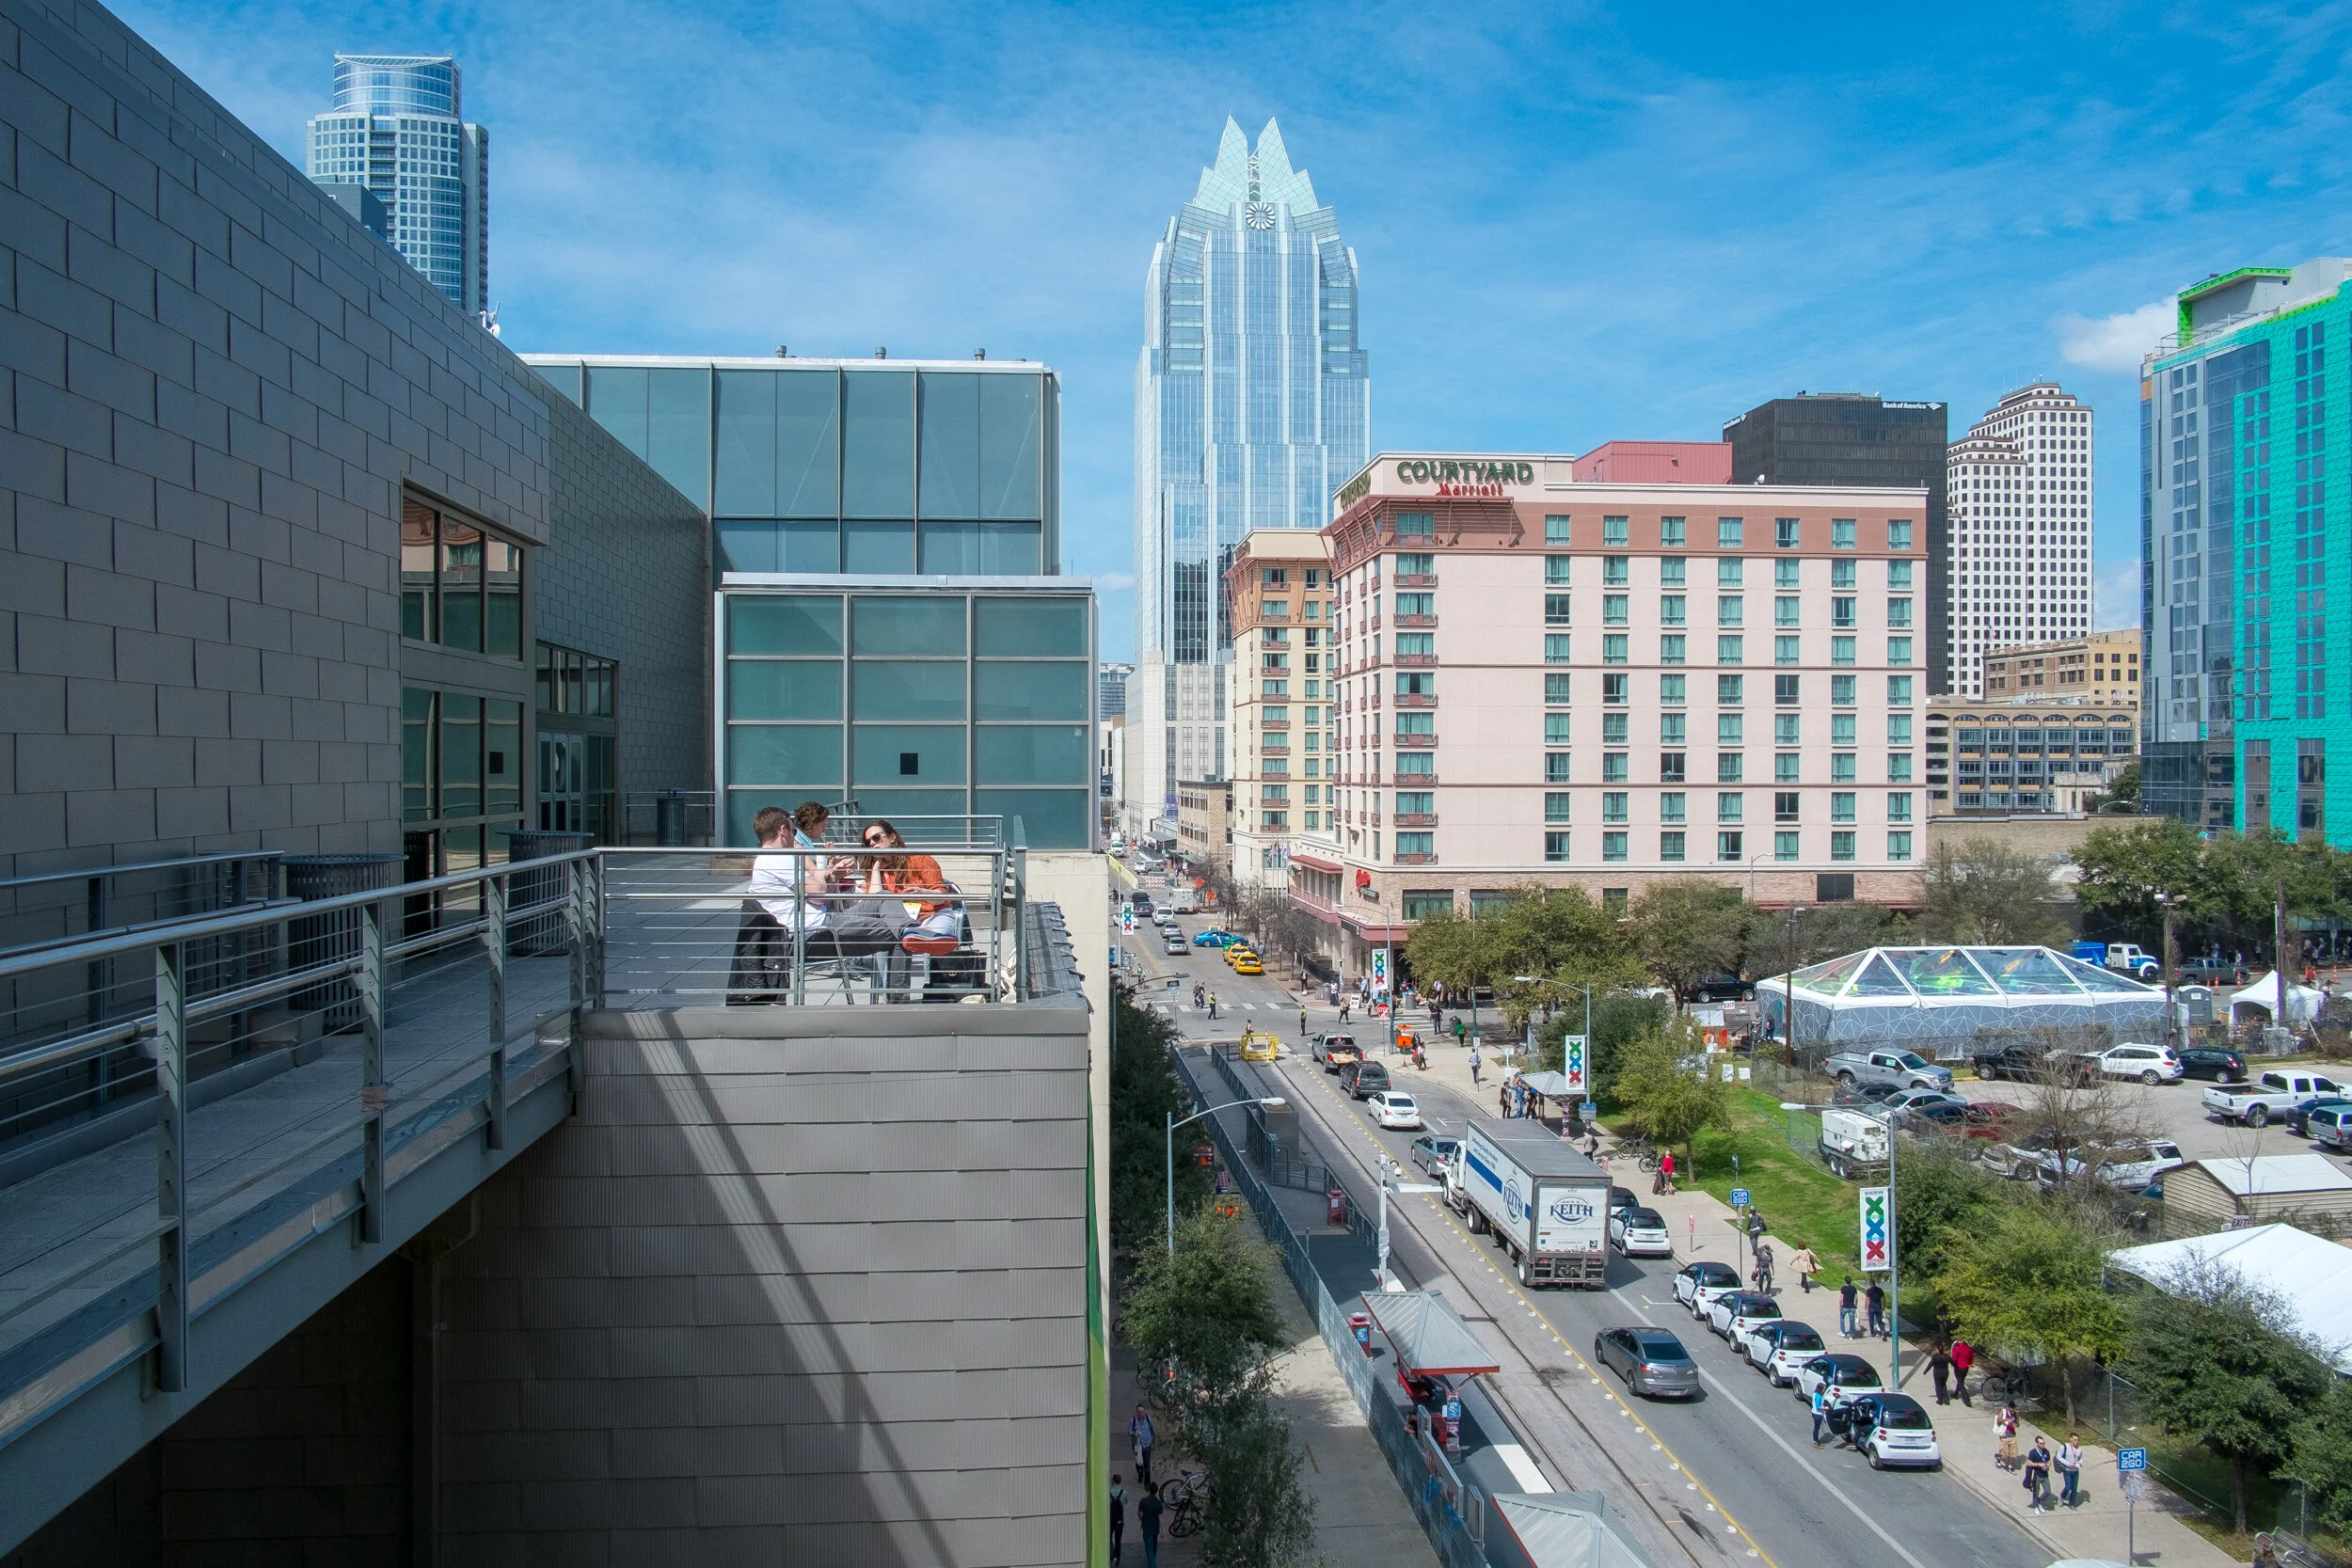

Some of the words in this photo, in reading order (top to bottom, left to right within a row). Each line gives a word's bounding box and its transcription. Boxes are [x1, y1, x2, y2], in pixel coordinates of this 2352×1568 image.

[1397, 461, 1533, 482] COURTYARD
[1435, 483, 1503, 497] Marriott
[1503, 1186, 1522, 1219] KEITH
[1550, 1204, 1593, 1217] KEITH
[2122, 1459, 2142, 1468] 2GO
